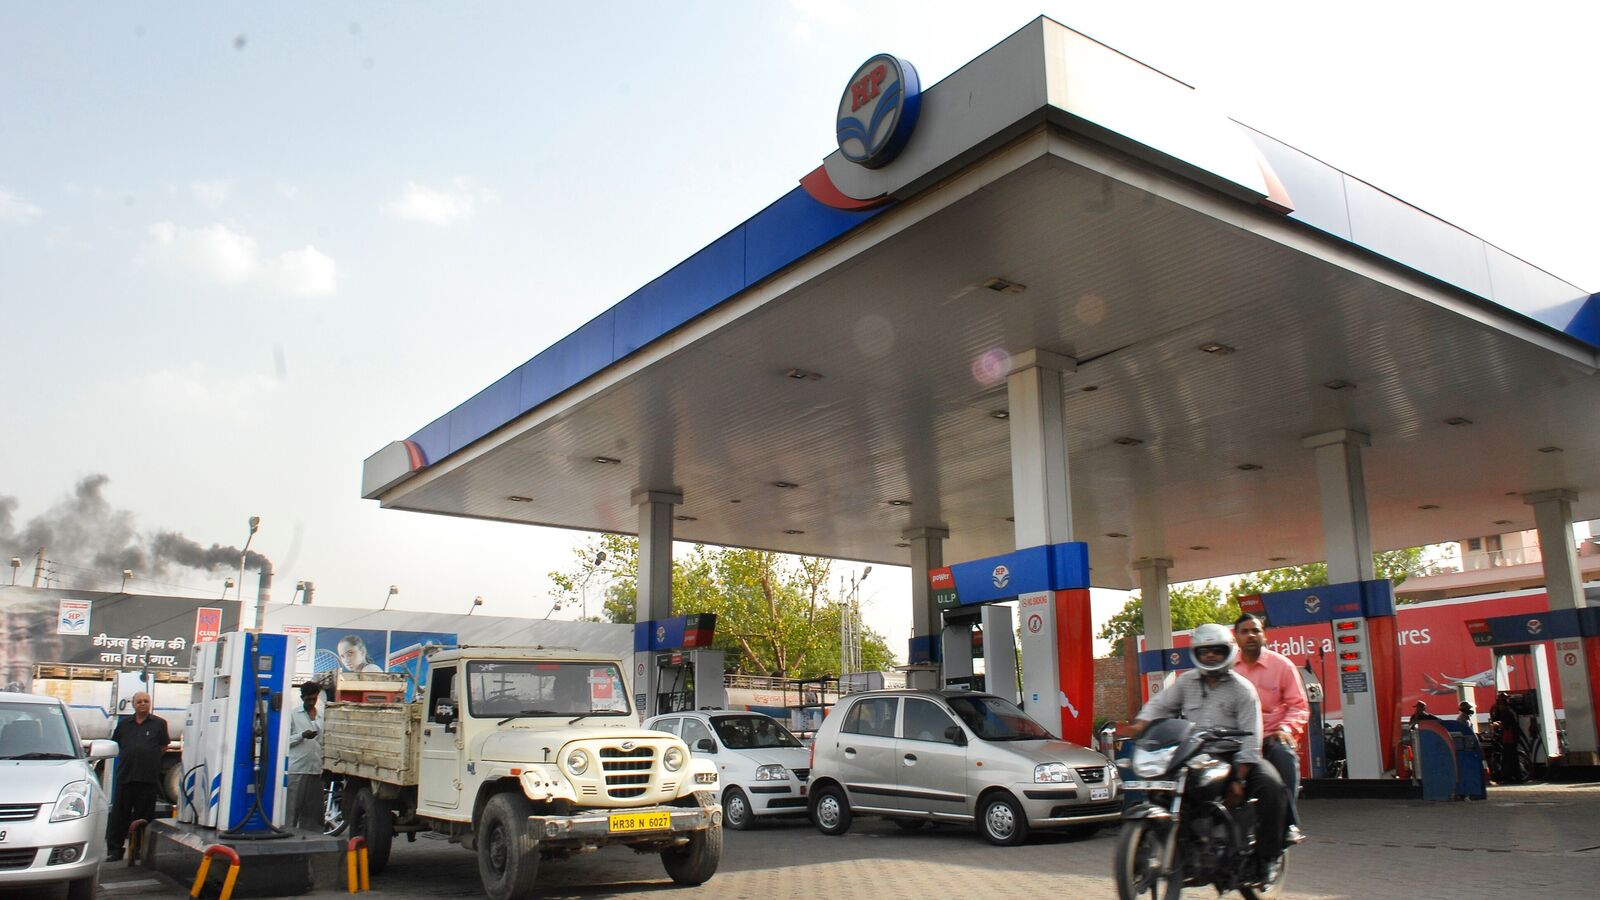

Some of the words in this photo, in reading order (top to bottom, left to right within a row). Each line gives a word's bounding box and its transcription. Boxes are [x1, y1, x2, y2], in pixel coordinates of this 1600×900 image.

[850, 64, 886, 113] HP
[932, 573, 950, 583] power
[168, 637, 186, 650] की
[1267, 635, 1315, 657] rtable
[612, 819, 634, 830] HR38
[639, 818, 645, 828] N
[649, 817, 668, 827] 6027
